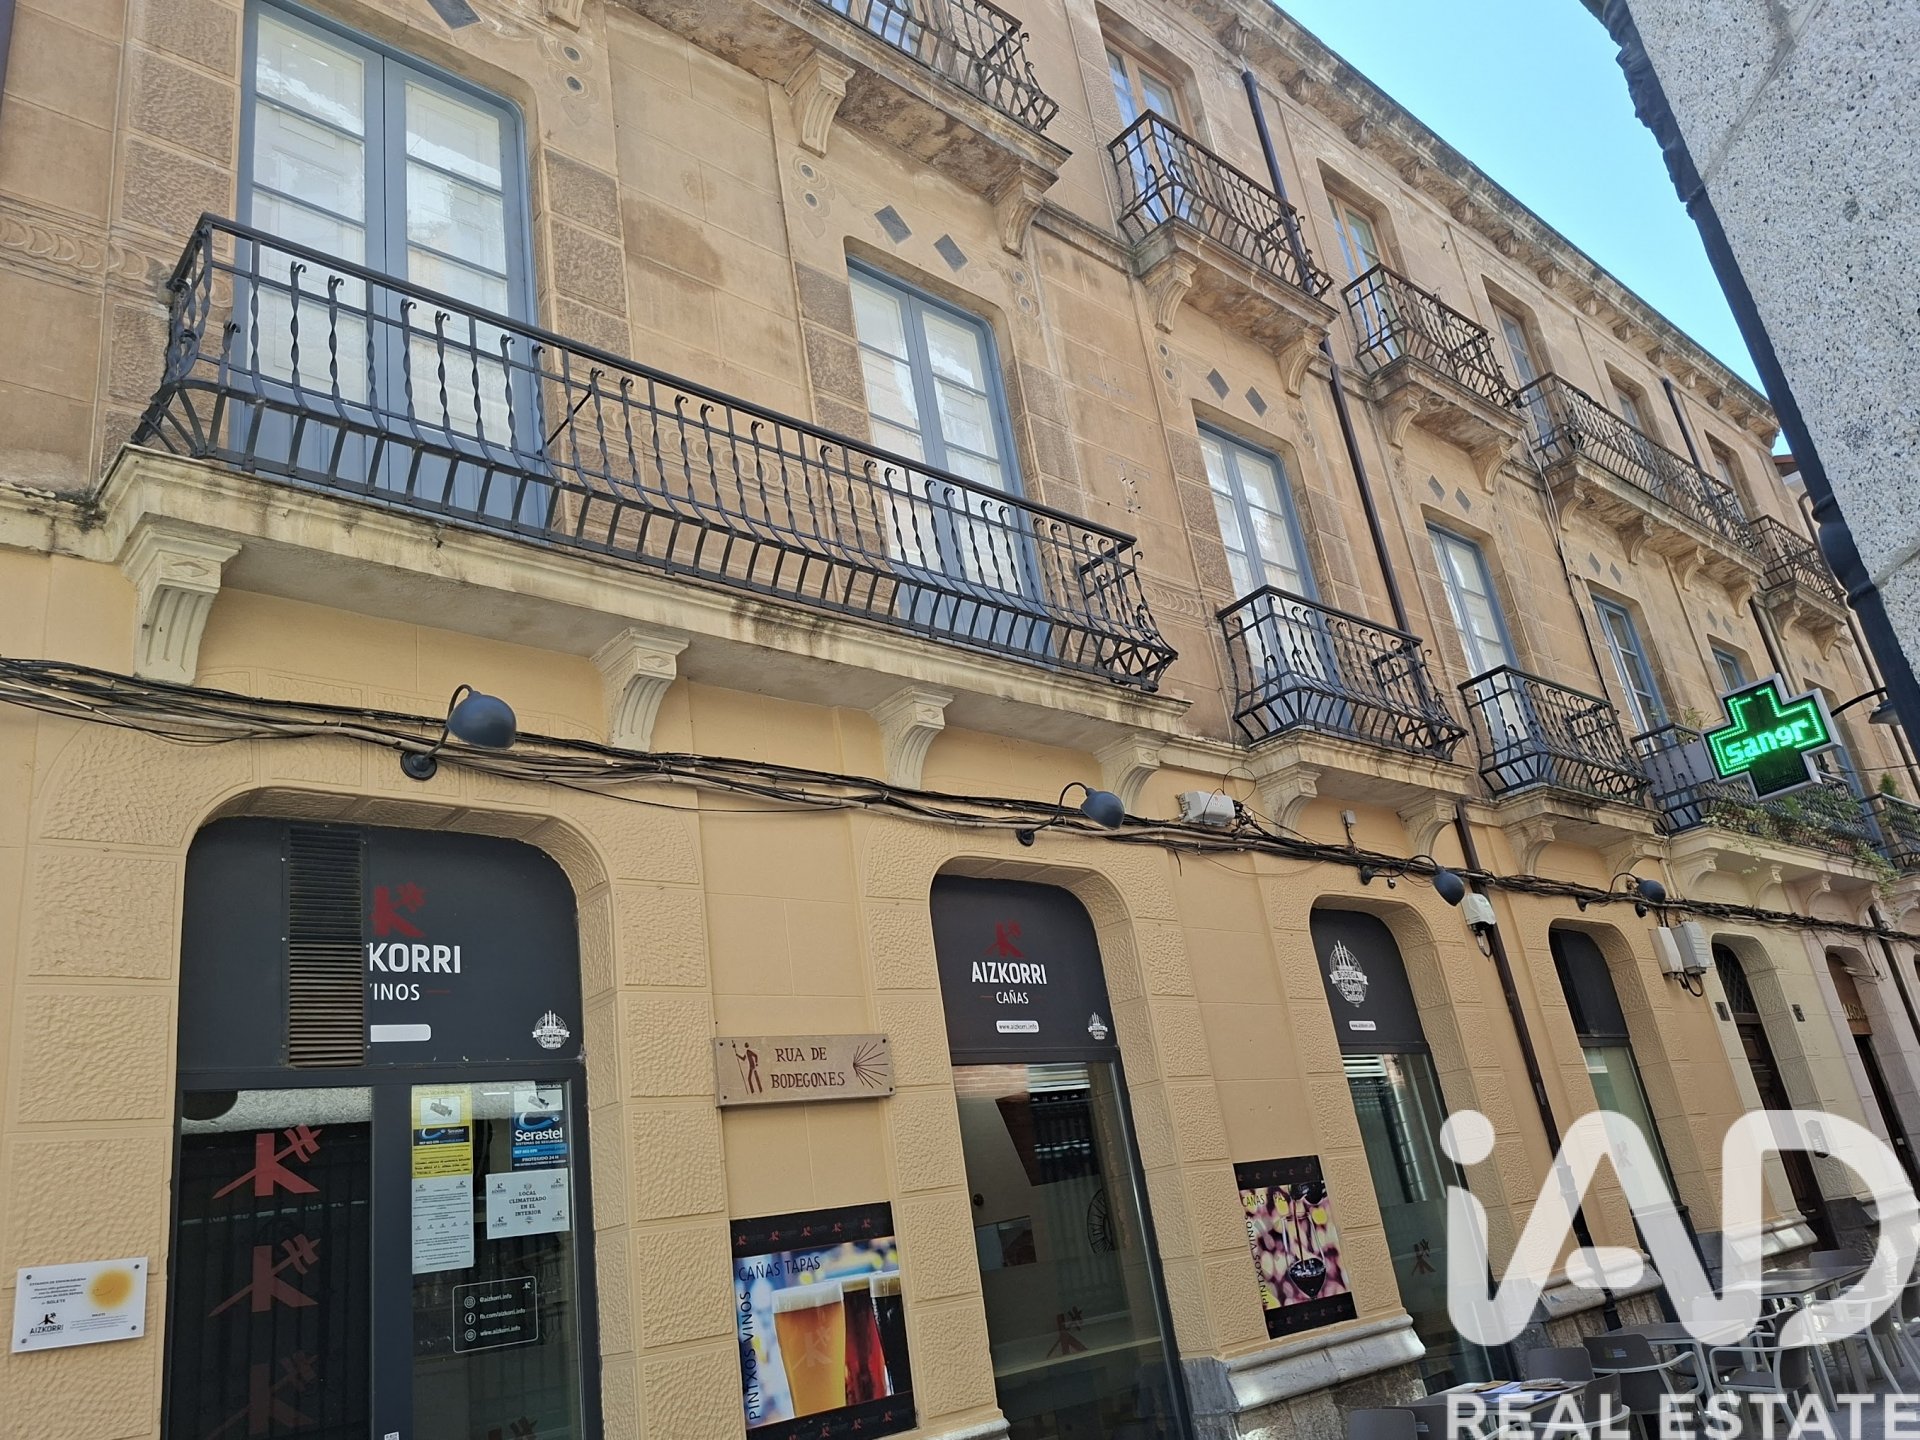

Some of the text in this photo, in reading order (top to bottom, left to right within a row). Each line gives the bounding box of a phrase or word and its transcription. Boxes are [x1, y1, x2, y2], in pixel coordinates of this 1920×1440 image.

[1725, 718, 1809, 765] sangr
[971, 961, 1048, 985] AIZKORRI
[369, 982, 421, 1001] INOS
[995, 989, 1029, 1005] CAÑAS
[775, 1047, 828, 1062] RUA DE
[771, 1071, 846, 1089] BODEGONES
[514, 1126, 563, 1142] Serastel
[738, 1255, 821, 1282] CAÑAS TAPAS
[29, 1324, 64, 1335] AIZKORRI
[740, 1291, 761, 1421] PINTXOS VINOS
